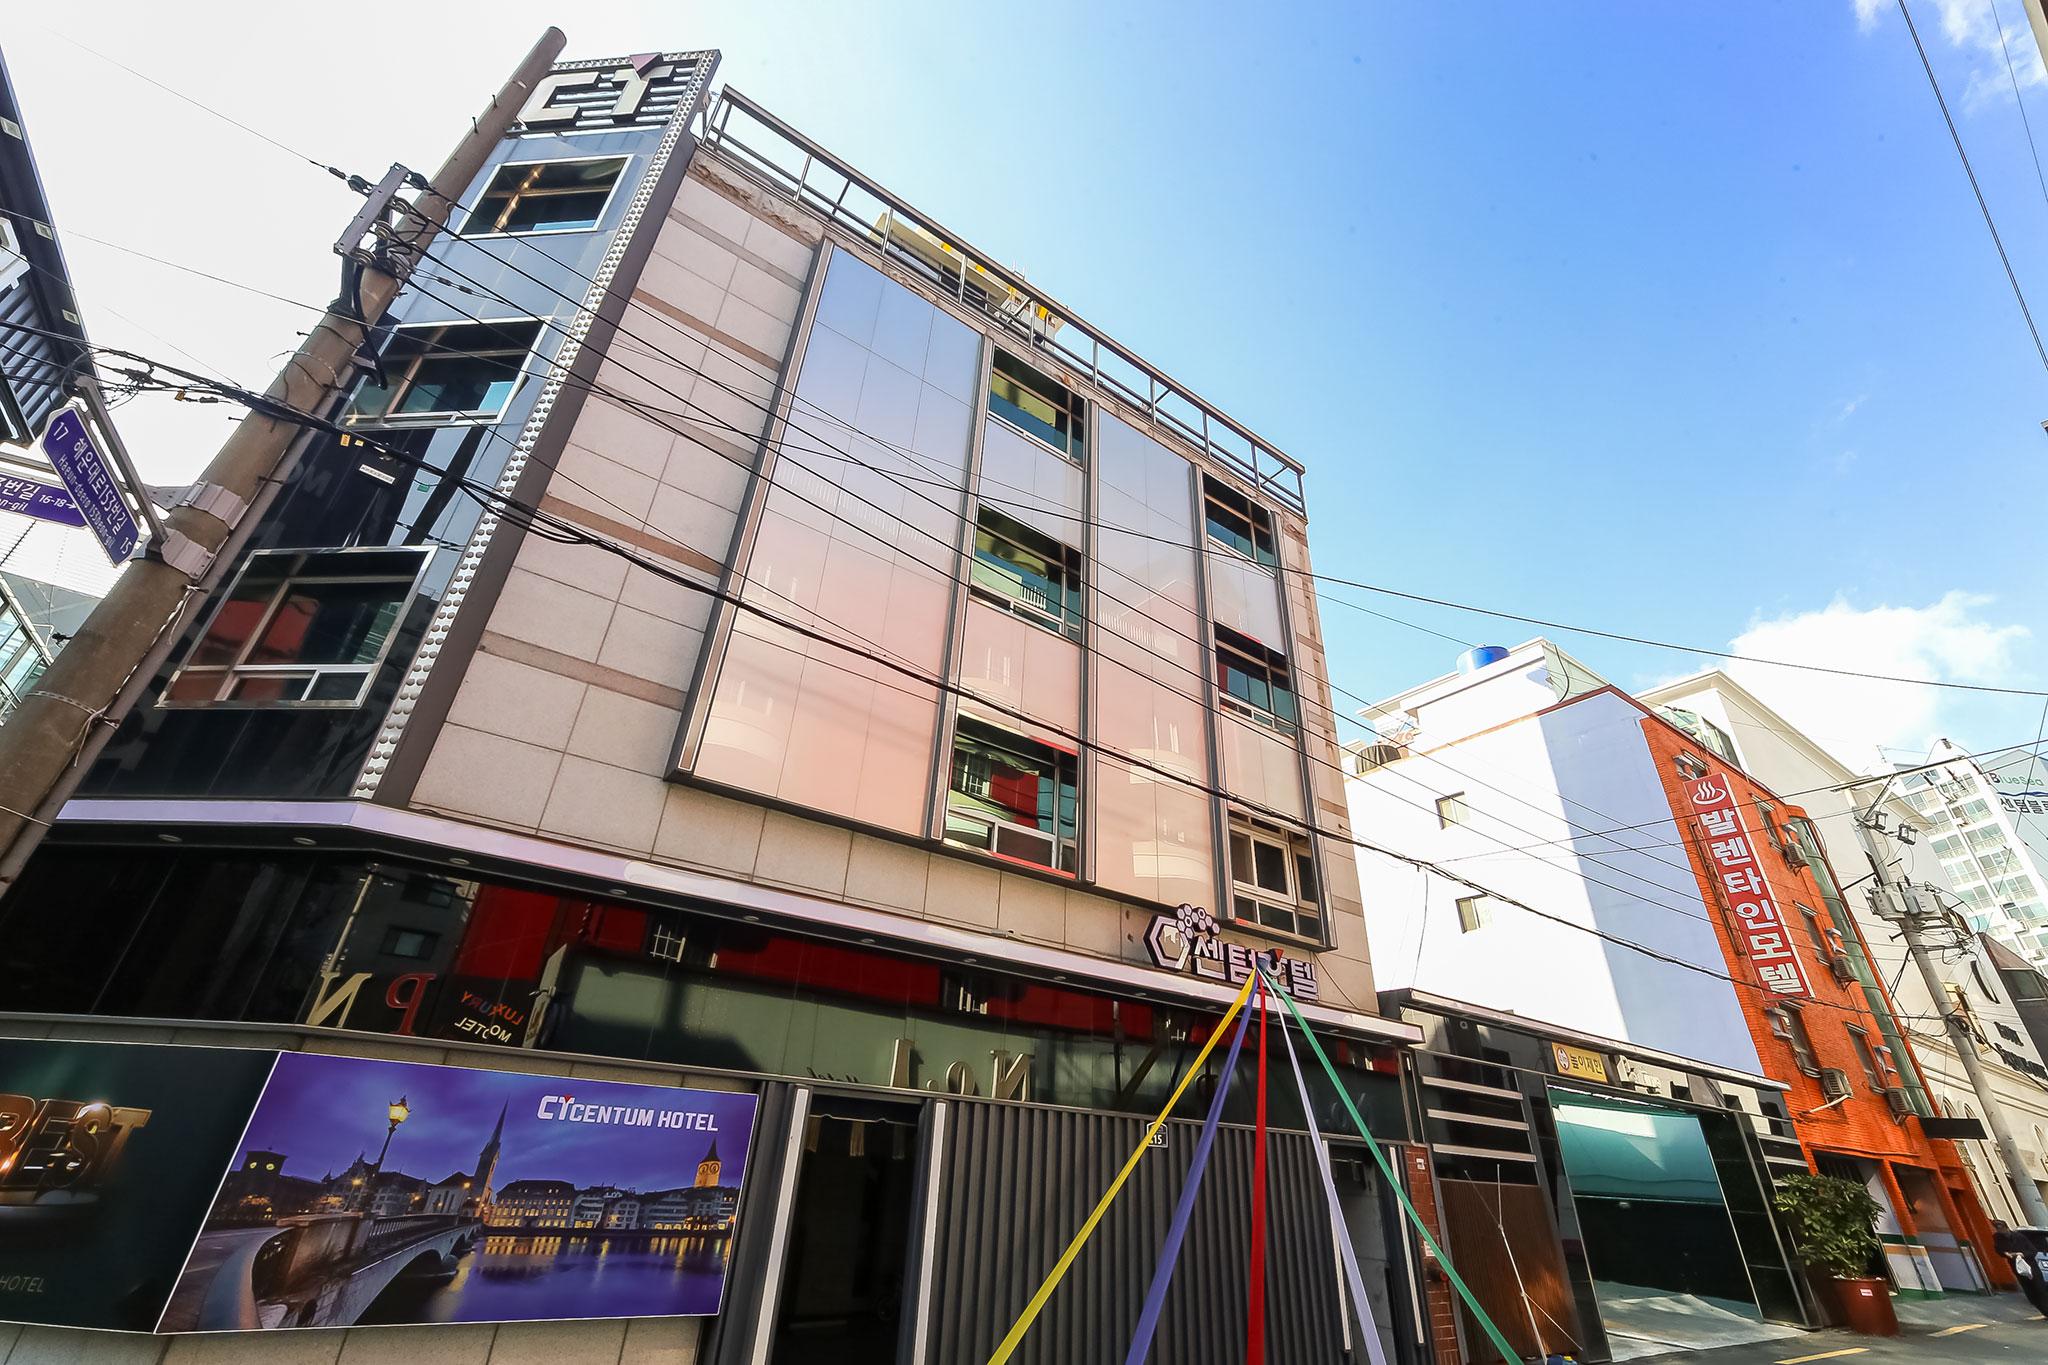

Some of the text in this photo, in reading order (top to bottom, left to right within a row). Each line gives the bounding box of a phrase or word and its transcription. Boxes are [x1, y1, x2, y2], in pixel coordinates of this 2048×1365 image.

[516, 53, 675, 123] CY
[53, 421, 69, 441] 17
[57, 453, 91, 507] Haeun-daero
[73, 437, 128, 535] 해운대로153번길
[120, 536, 133, 555] 15
[1989, 772, 2044, 787] BlueSea
[1700, 808, 1804, 995] 발렌타인모텔
[657, 1111, 719, 1132] HOTEL
[0, 1275, 45, 1293] HOTEL
